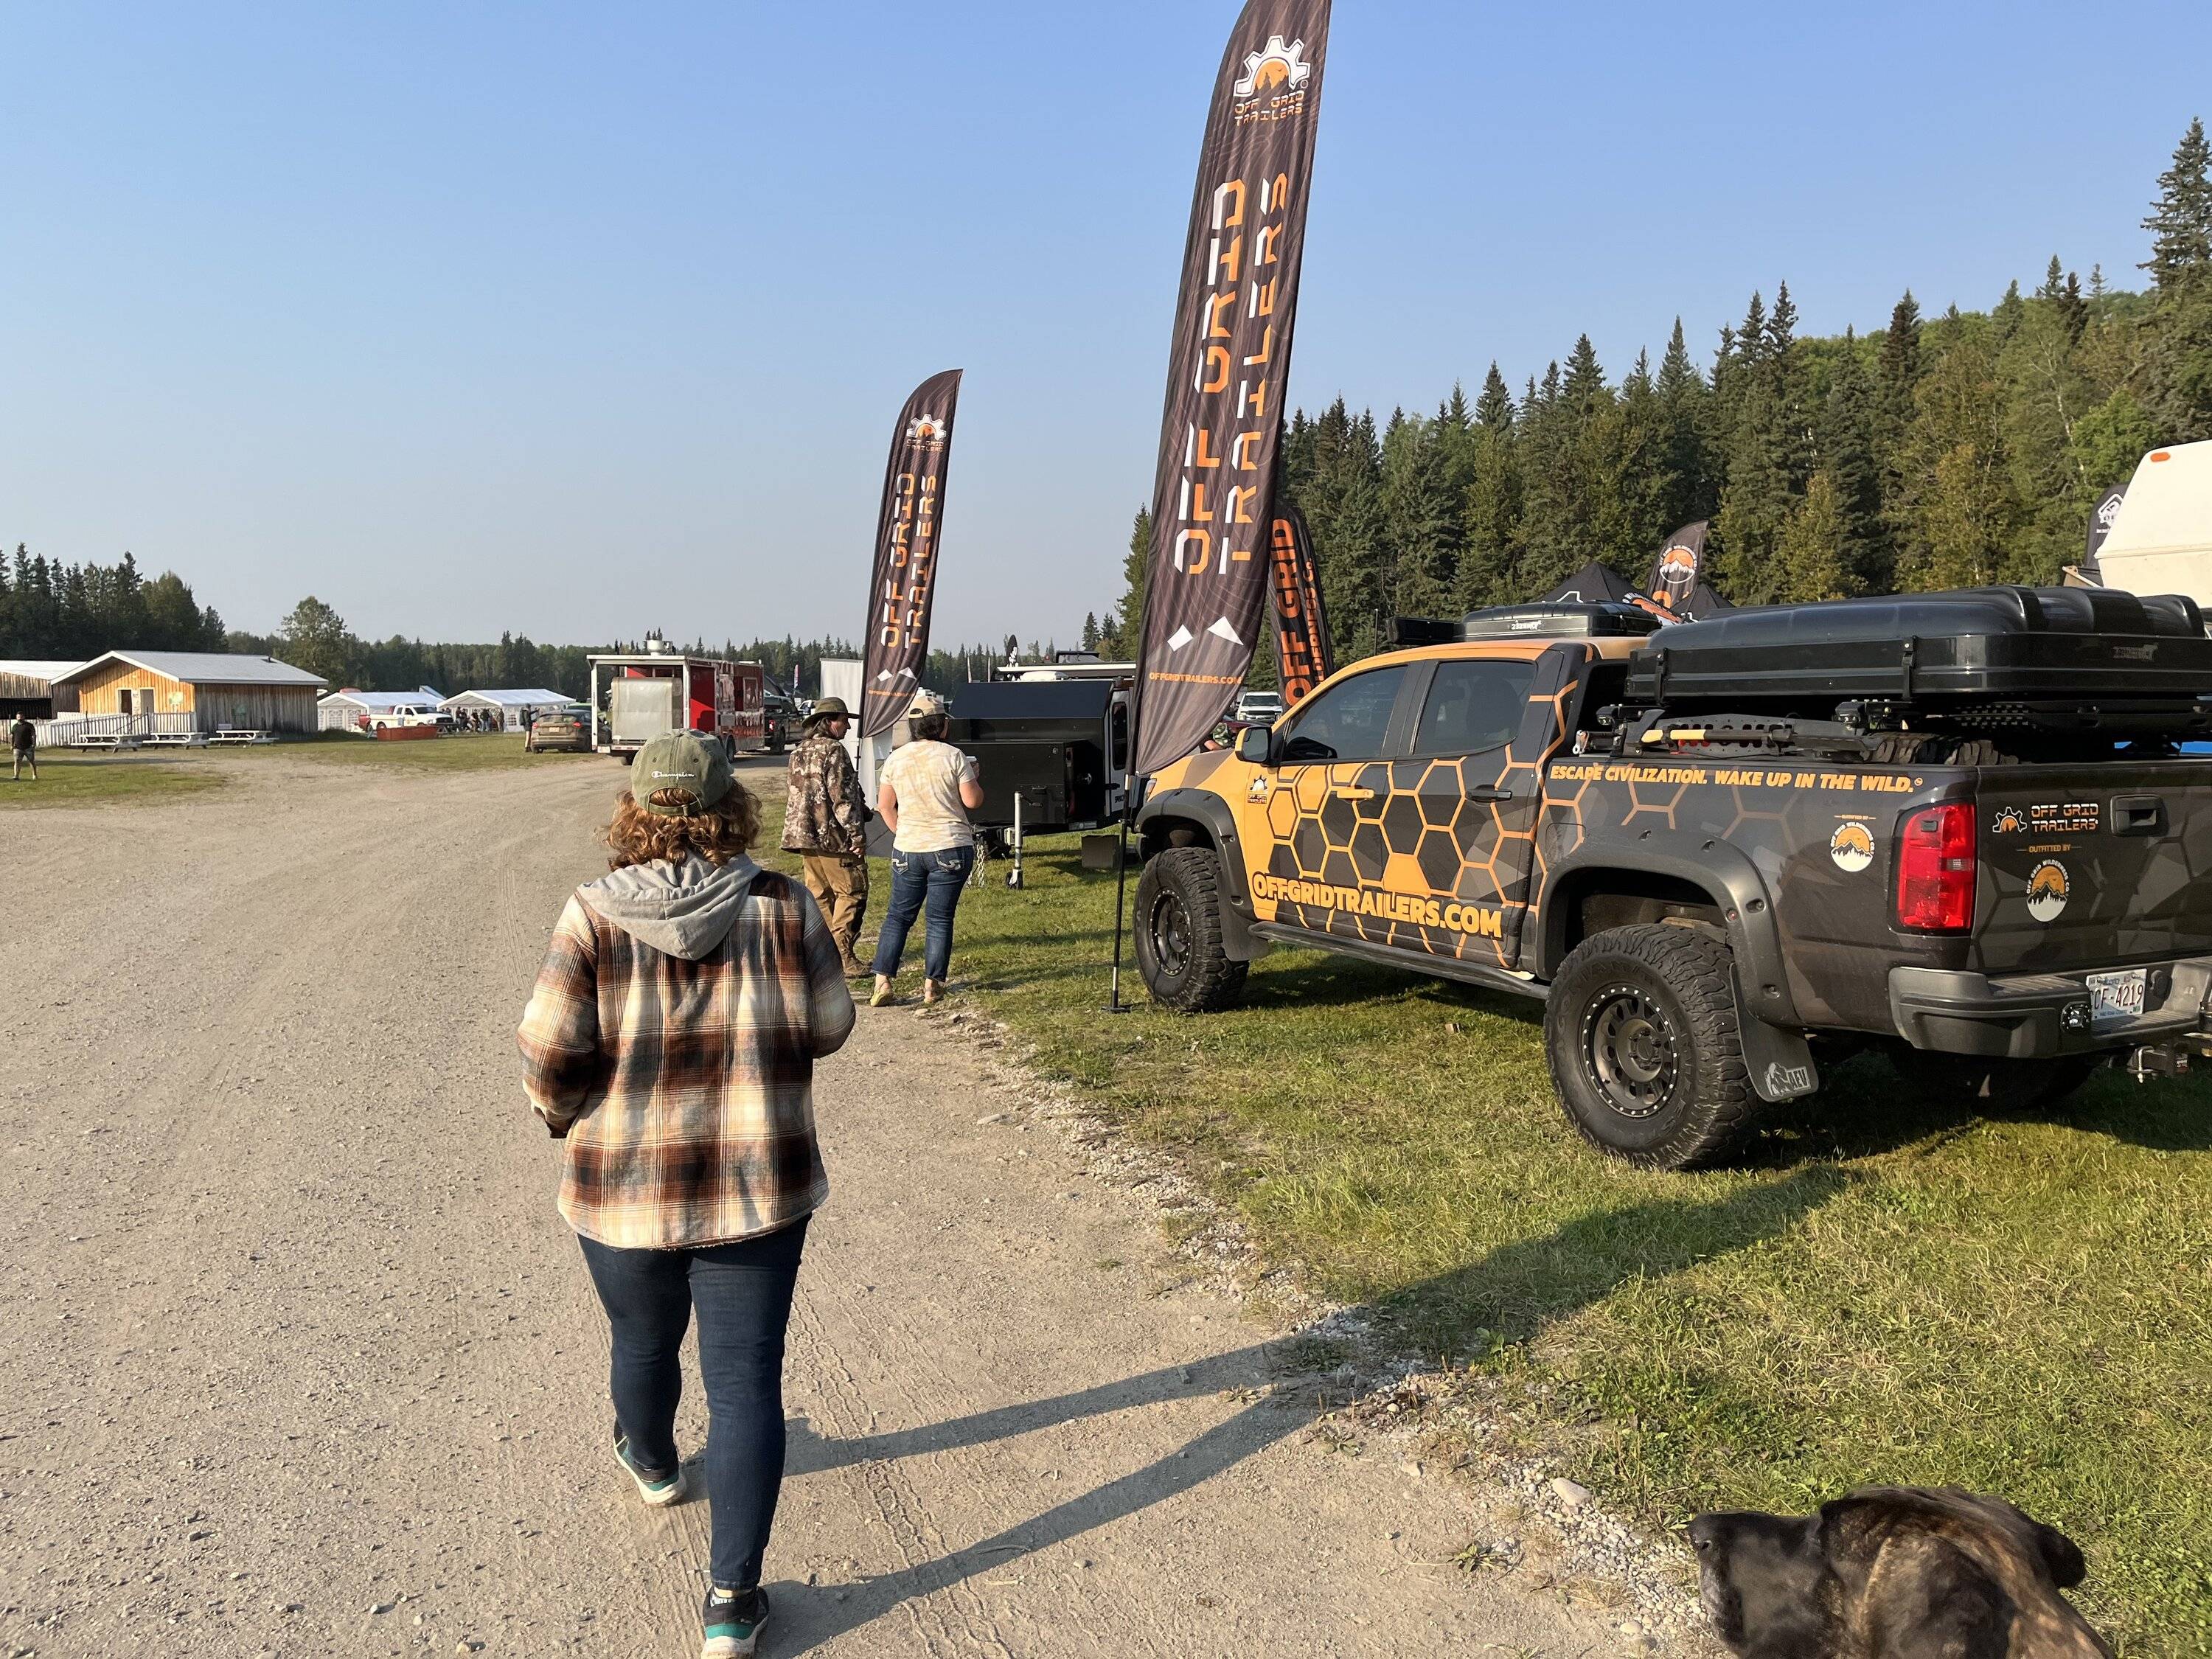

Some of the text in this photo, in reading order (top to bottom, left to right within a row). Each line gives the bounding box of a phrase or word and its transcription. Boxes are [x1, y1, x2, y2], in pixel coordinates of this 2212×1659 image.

[1234, 89, 1304, 114] OFF GRID
[1234, 103, 1303, 126] TRAILERS
[1174, 178, 1245, 574] OFF GRID
[1218, 173, 1287, 575] TRAILERS
[880, 473, 915, 647] OFF GRID
[904, 474, 936, 649] TRAILERS
[1270, 518, 1312, 706] OFF GRID
[1305, 587, 1325, 684] LDERNESS
[651, 771, 695, 780] Champion
[1550, 765, 1602, 781] ESCAPE
[1605, 766, 1708, 784] CIVILIZATION.
[1714, 770, 1763, 786] WAKE
[1766, 771, 1789, 787] UP
[1794, 773, 1818, 788] IN
[1820, 773, 1854, 790] THE
[2031, 803, 2099, 818] OFF GRID
[1254, 872, 1503, 939] OFFGRIDTRAILERS.COM
